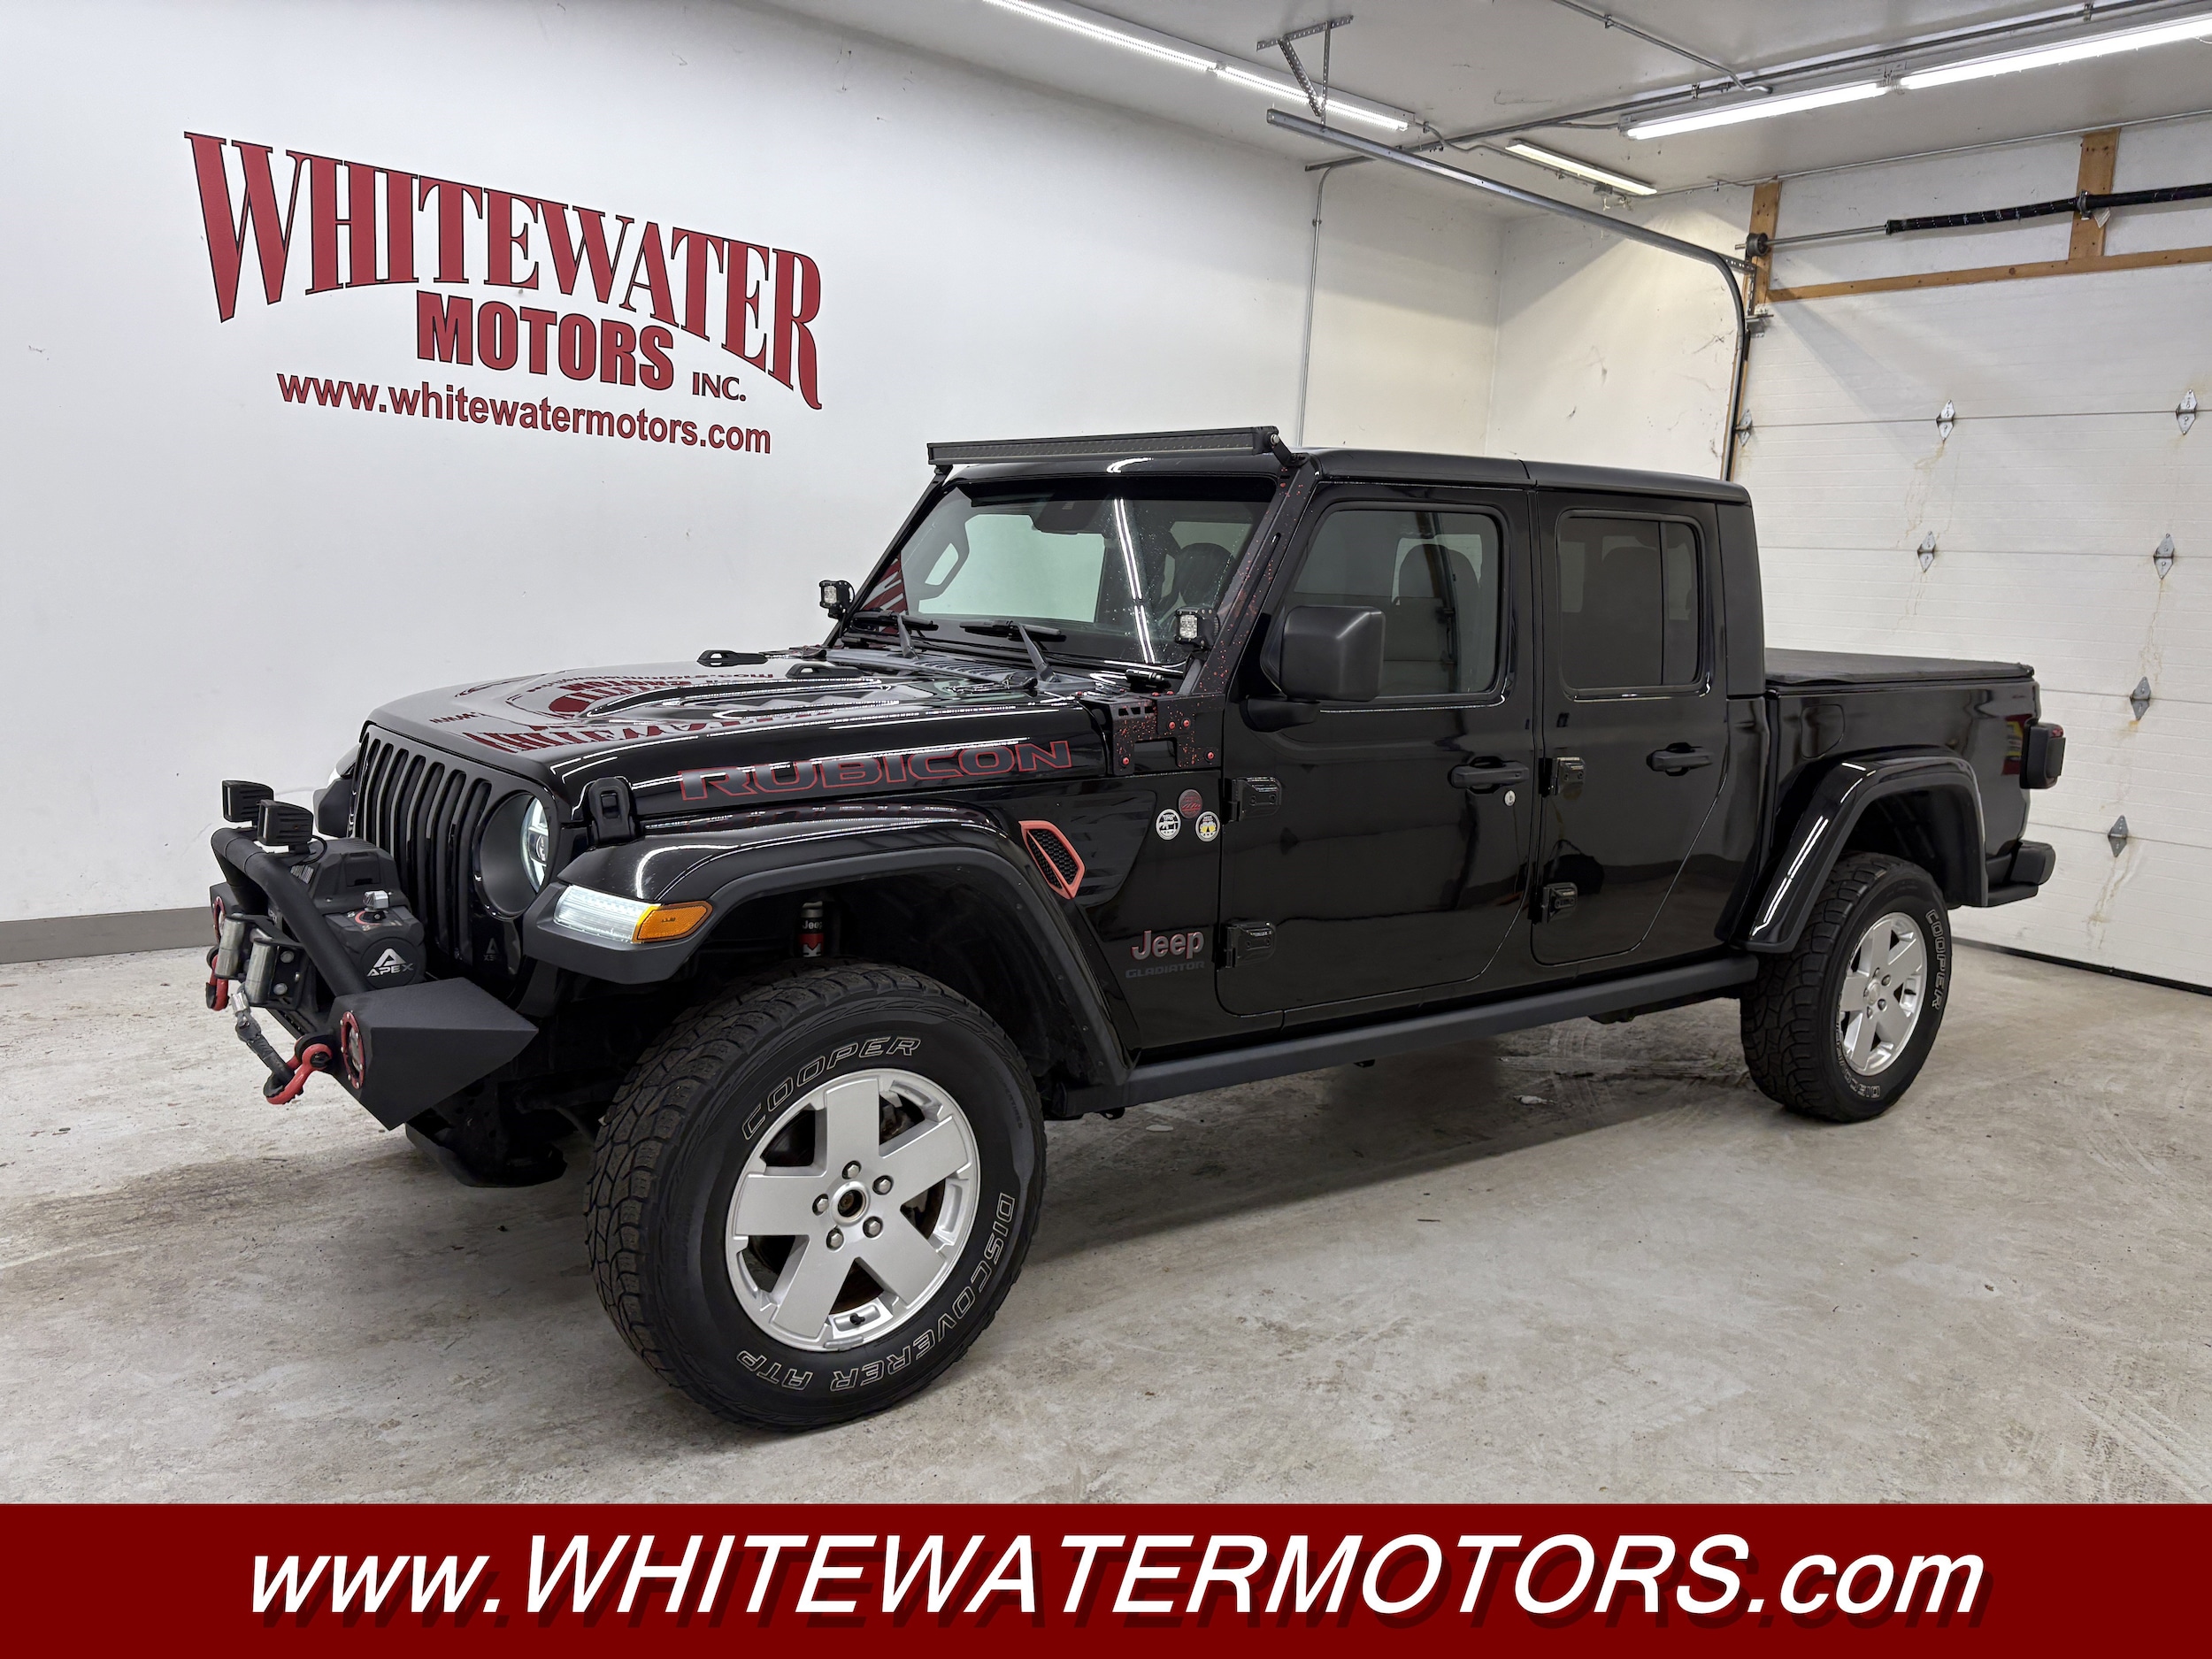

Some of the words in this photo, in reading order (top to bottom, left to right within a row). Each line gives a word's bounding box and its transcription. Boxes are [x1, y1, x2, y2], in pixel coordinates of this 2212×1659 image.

[183, 130, 822, 410] WHITEWATER
[416, 289, 675, 391] MOTORS
[692, 371, 747, 403] INC.
[276, 373, 772, 455] www.whitewatermotors.com
[677, 740, 1072, 801] RUBICON
[366, 963, 414, 977] APEX
[1125, 961, 1206, 979] GLADIATOR
[1131, 930, 1205, 960] Jeep
[1925, 909, 1946, 1010] COOPER
[741, 1036, 922, 1141] COOPER
[829, 1192, 1017, 1393] DISCOVERER
[735, 1348, 814, 1392] ATP
